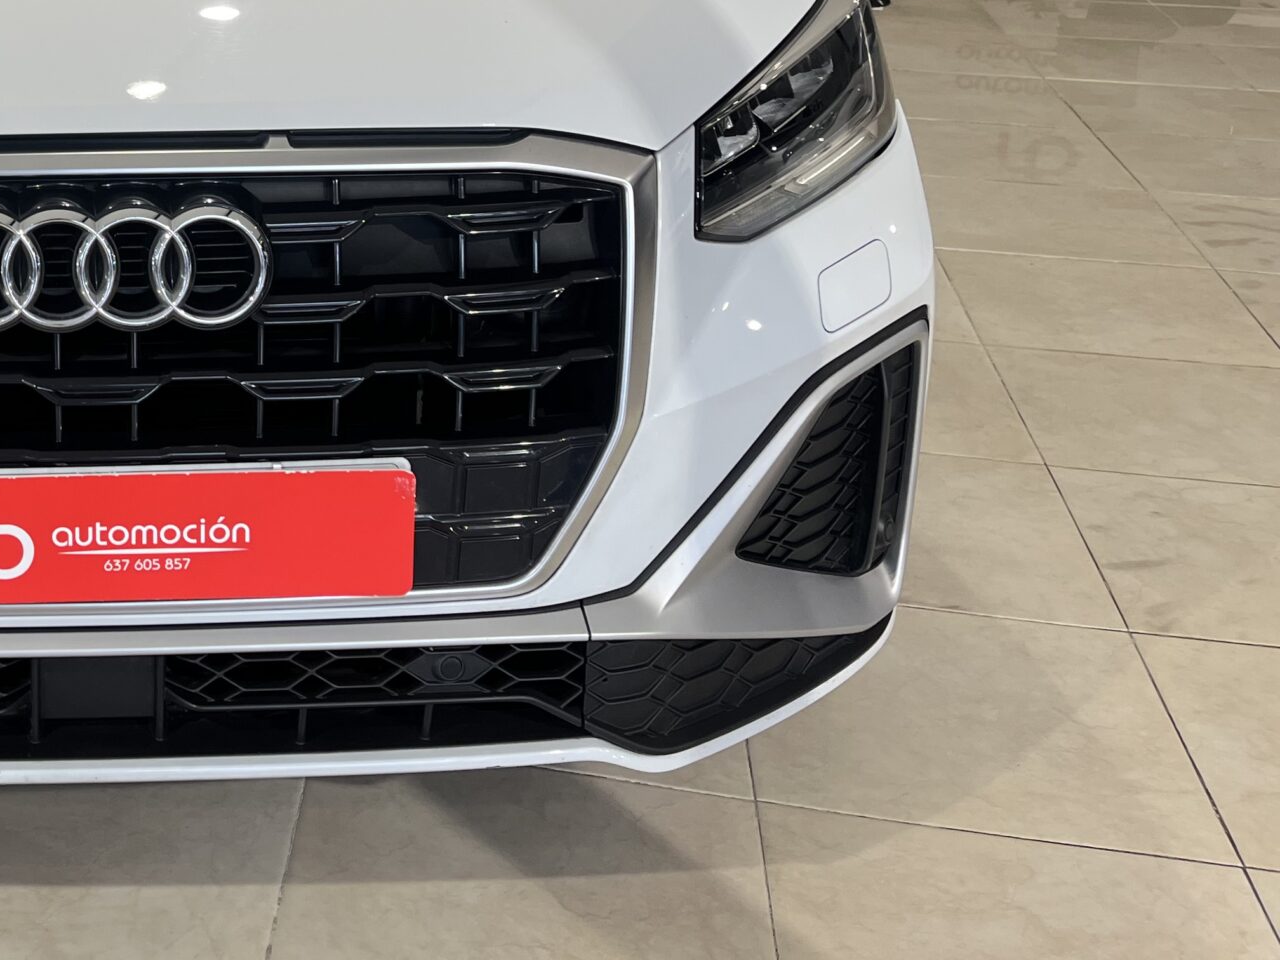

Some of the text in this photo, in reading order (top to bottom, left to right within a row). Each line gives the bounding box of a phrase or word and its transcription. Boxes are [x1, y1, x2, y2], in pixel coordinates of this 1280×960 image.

[51, 516, 251, 547] automoción
[104, 557, 191, 572] 637 605 857
